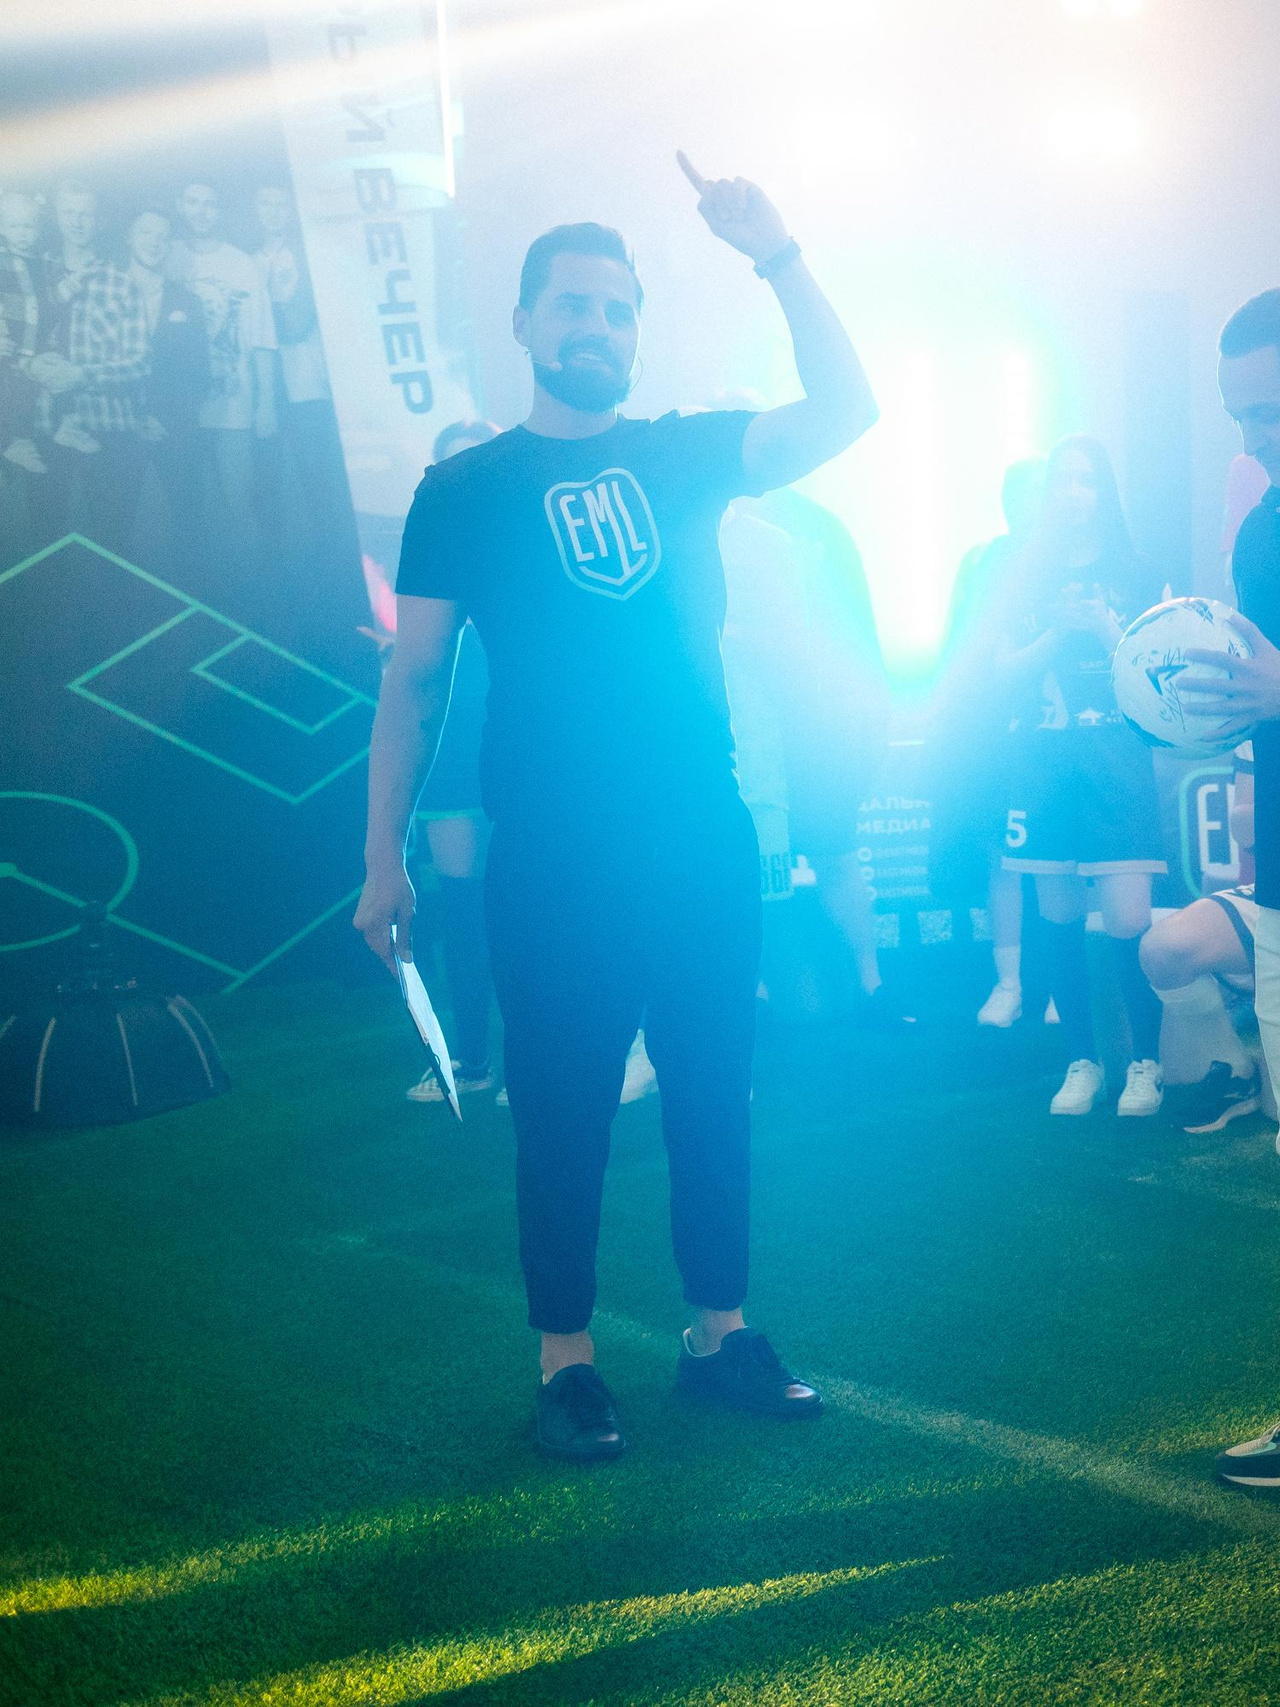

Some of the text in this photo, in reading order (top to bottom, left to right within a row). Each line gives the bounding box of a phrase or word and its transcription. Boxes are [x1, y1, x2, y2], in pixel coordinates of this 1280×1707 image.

[353, 167, 434, 415] ВЕЧЕР
[558, 480, 649, 587] EML
[1006, 810, 1029, 848] 5
